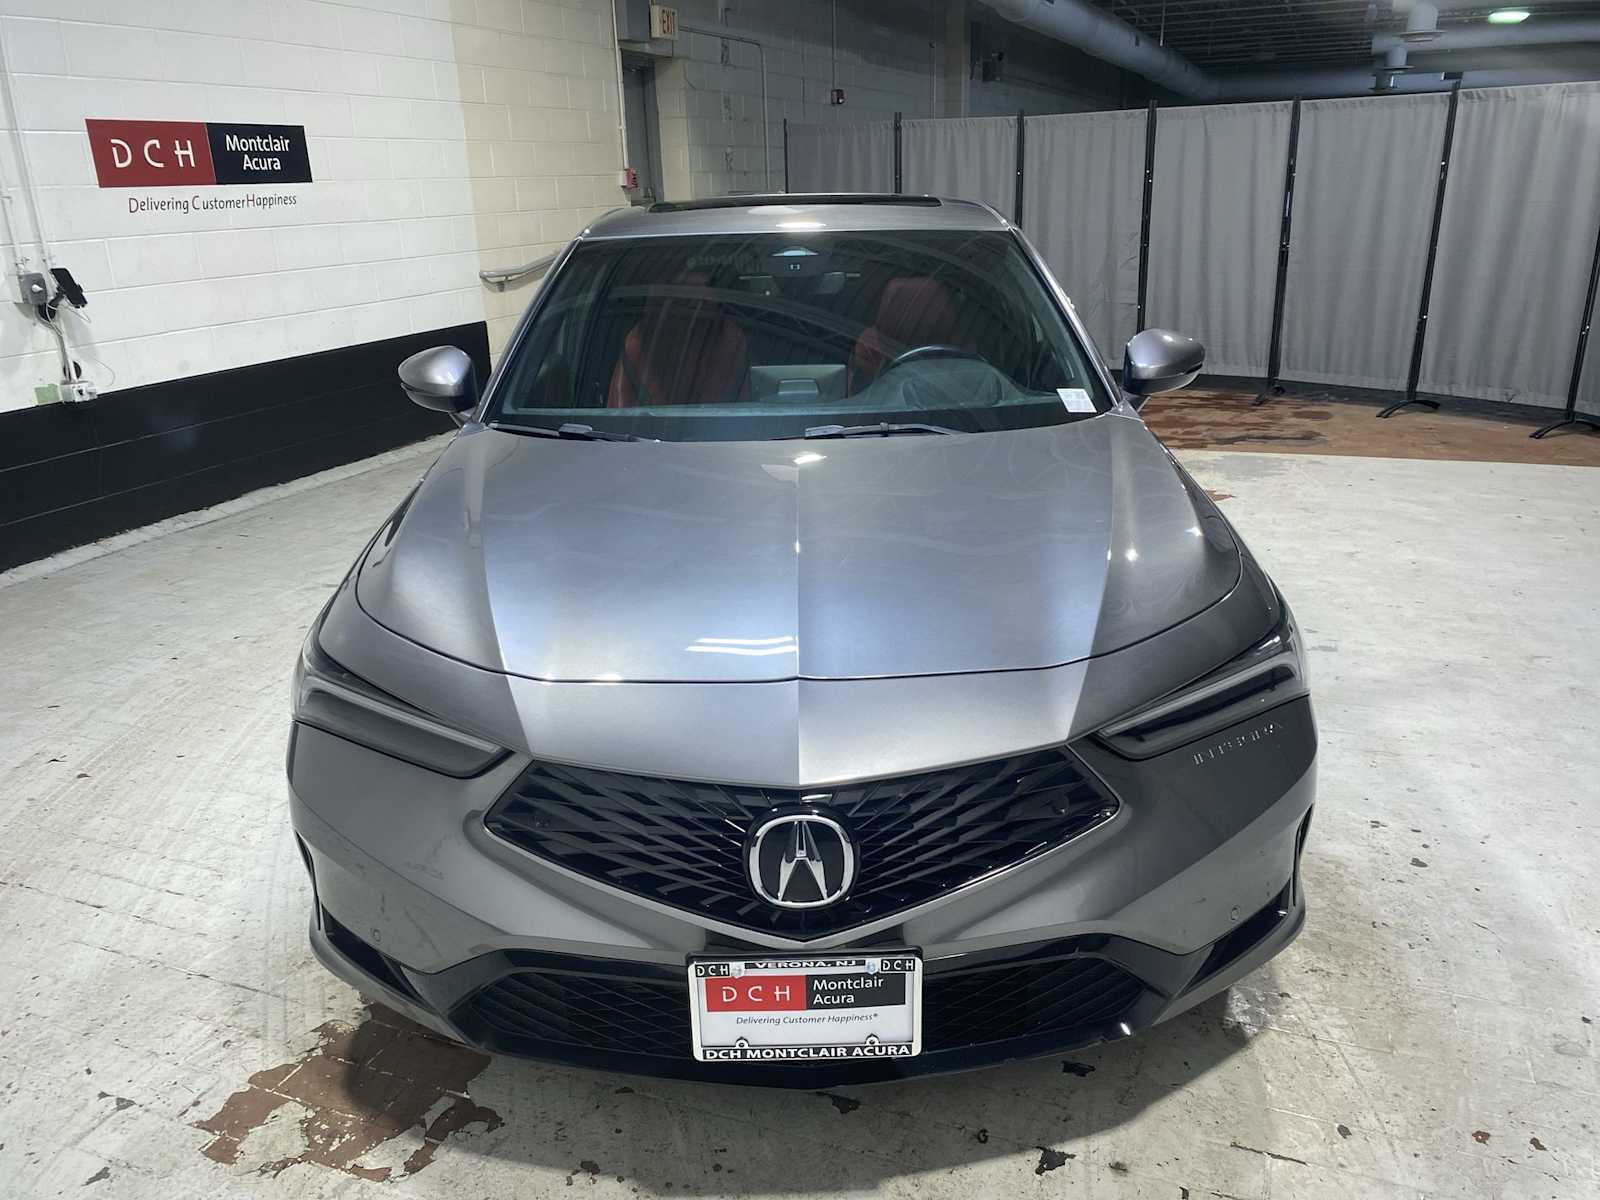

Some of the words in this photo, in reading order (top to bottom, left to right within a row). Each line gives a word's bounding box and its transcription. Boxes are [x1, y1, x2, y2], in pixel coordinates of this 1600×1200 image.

[225, 134, 290, 152] Montclair
[110, 138, 196, 168] DCH
[242, 154, 281, 171] Acura
[128, 197, 189, 214] Delivering
[191, 195, 246, 210] Customer
[246, 194, 297, 209] Happiness
[696, 965, 729, 977] DCH
[882, 959, 915, 971] DCH
[813, 976, 884, 991] Montclair
[721, 986, 790, 1003] DCH
[812, 993, 855, 1005] Acura
[735, 1016, 781, 1026] Delivering
[783, 1016, 826, 1024] Customer
[706, 1050, 742, 1060] DCH
[746, 1047, 850, 1059] MONTCLAIR
[852, 1045, 910, 1056] ACURA
